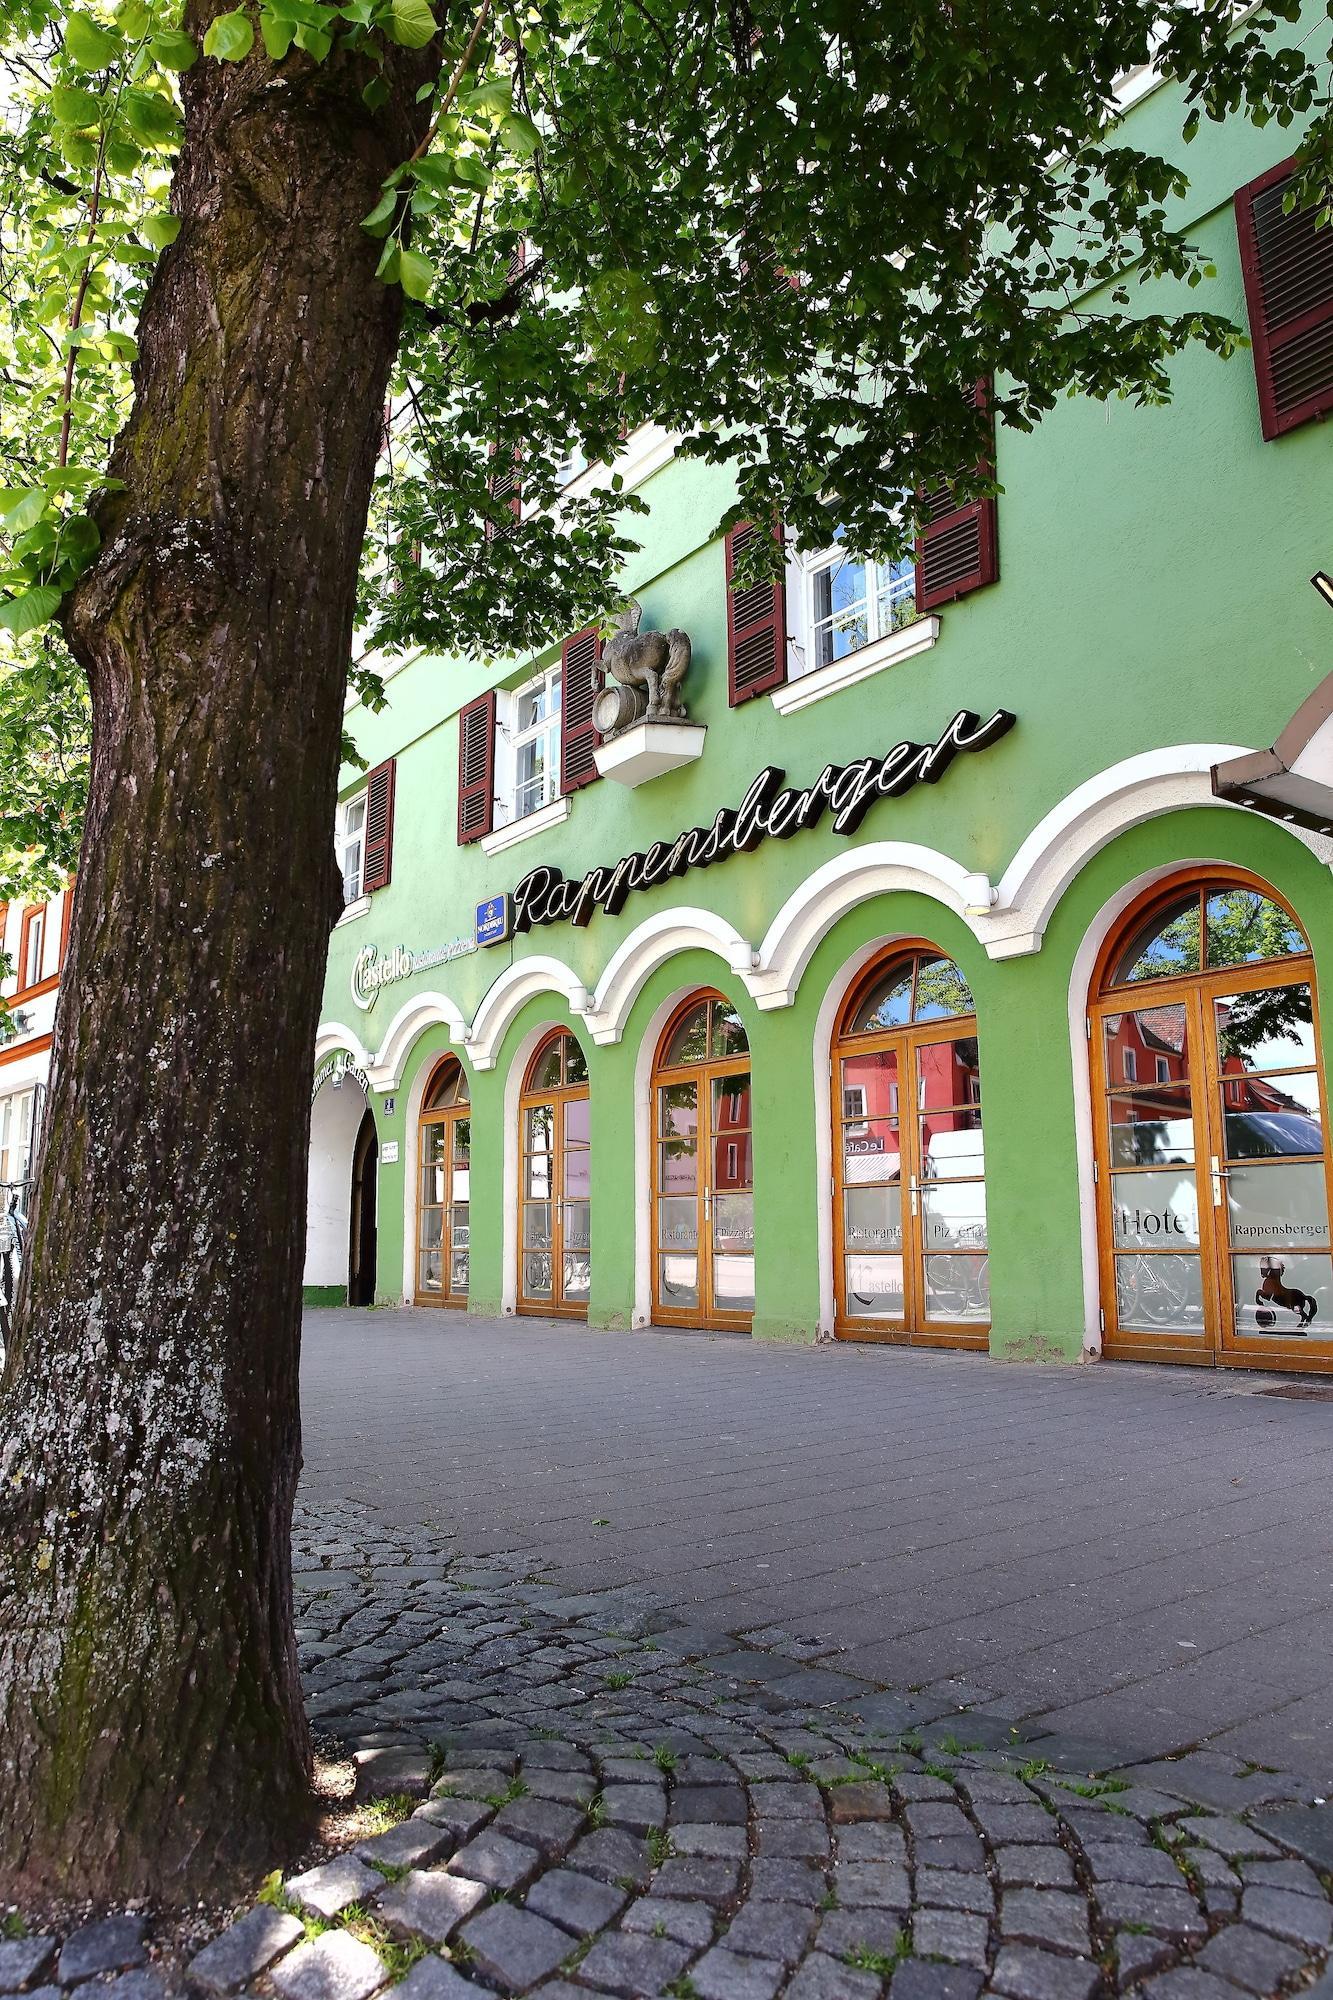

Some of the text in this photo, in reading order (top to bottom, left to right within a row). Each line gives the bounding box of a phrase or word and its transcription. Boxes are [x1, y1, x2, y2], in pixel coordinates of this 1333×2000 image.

[513, 709, 1010, 932] Rappensberger
[351, 944, 414, 1012] Castello
[934, 1223, 984, 1238] Pizeria
[1235, 1223, 1329, 1237] Rappensberger
